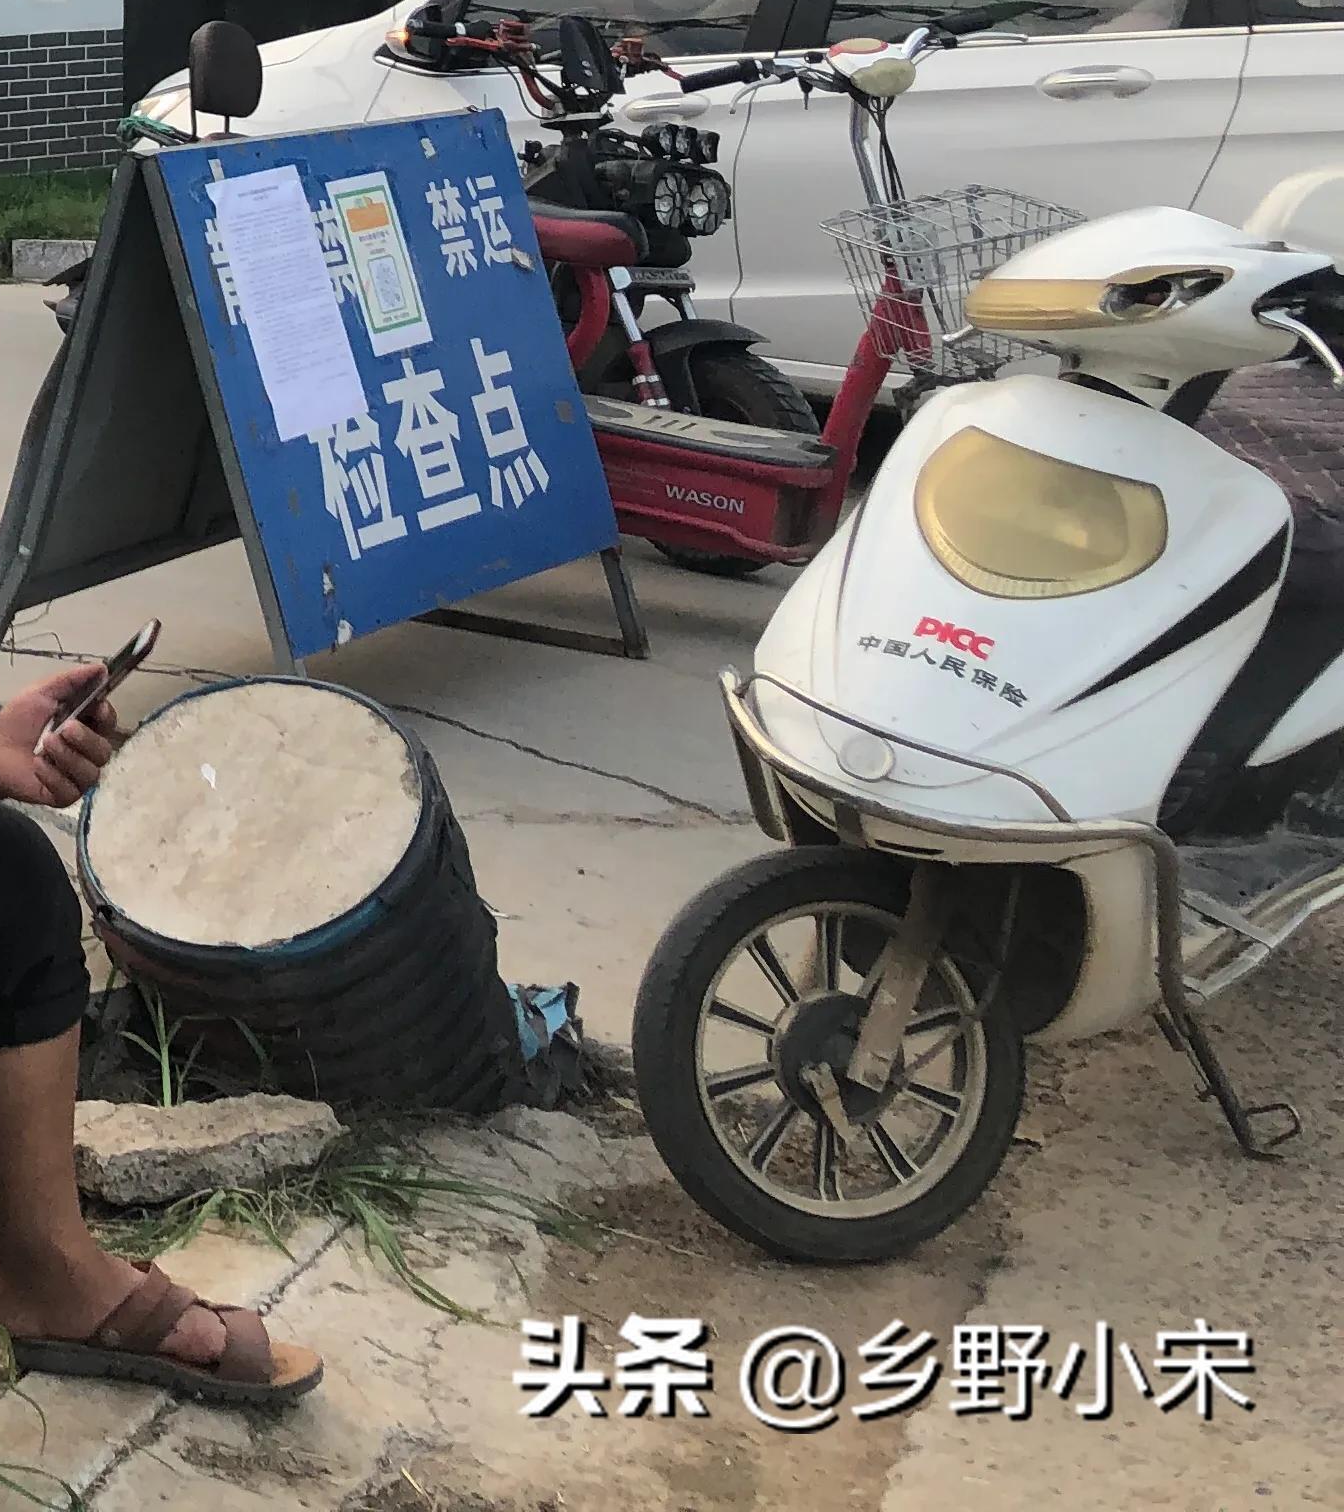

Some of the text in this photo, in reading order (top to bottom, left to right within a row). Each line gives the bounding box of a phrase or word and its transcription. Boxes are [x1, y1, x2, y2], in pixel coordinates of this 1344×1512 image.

[308, 337, 550, 560] 检查点
[665, 484, 745, 514] WASON
[915, 617, 994, 660] PICC
[858, 634, 1027, 707] 中国人民保险
